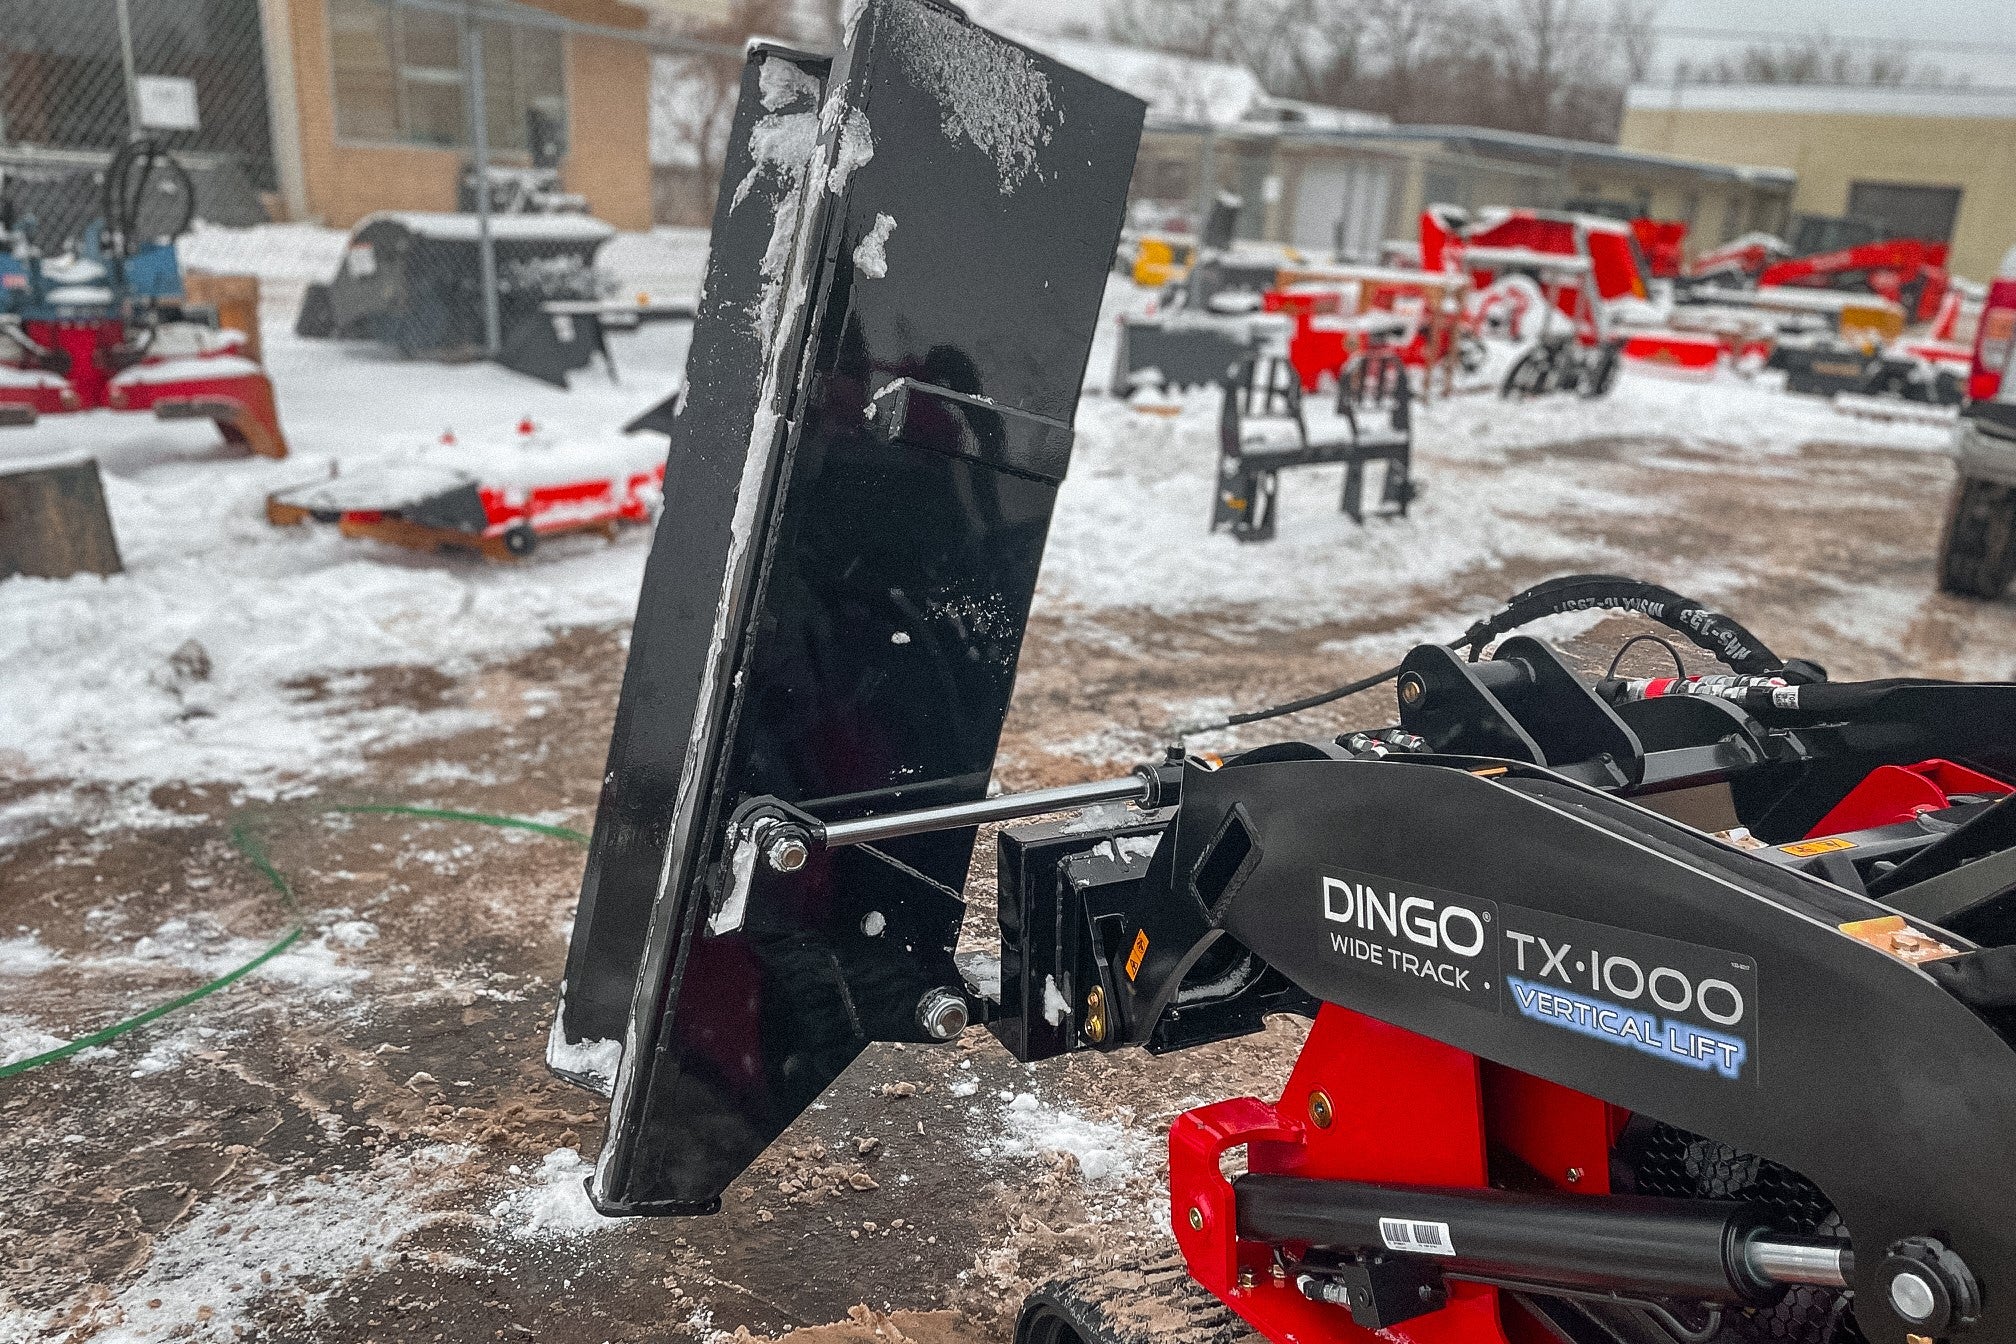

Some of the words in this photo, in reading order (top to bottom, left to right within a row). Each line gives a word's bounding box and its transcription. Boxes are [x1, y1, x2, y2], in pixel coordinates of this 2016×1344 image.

[1330, 932, 1383, 965] WIDE
[1387, 948, 1471, 991] TRACK
[1516, 984, 1662, 1048] VERTICAL
[1670, 1027, 1738, 1069] LIFT
